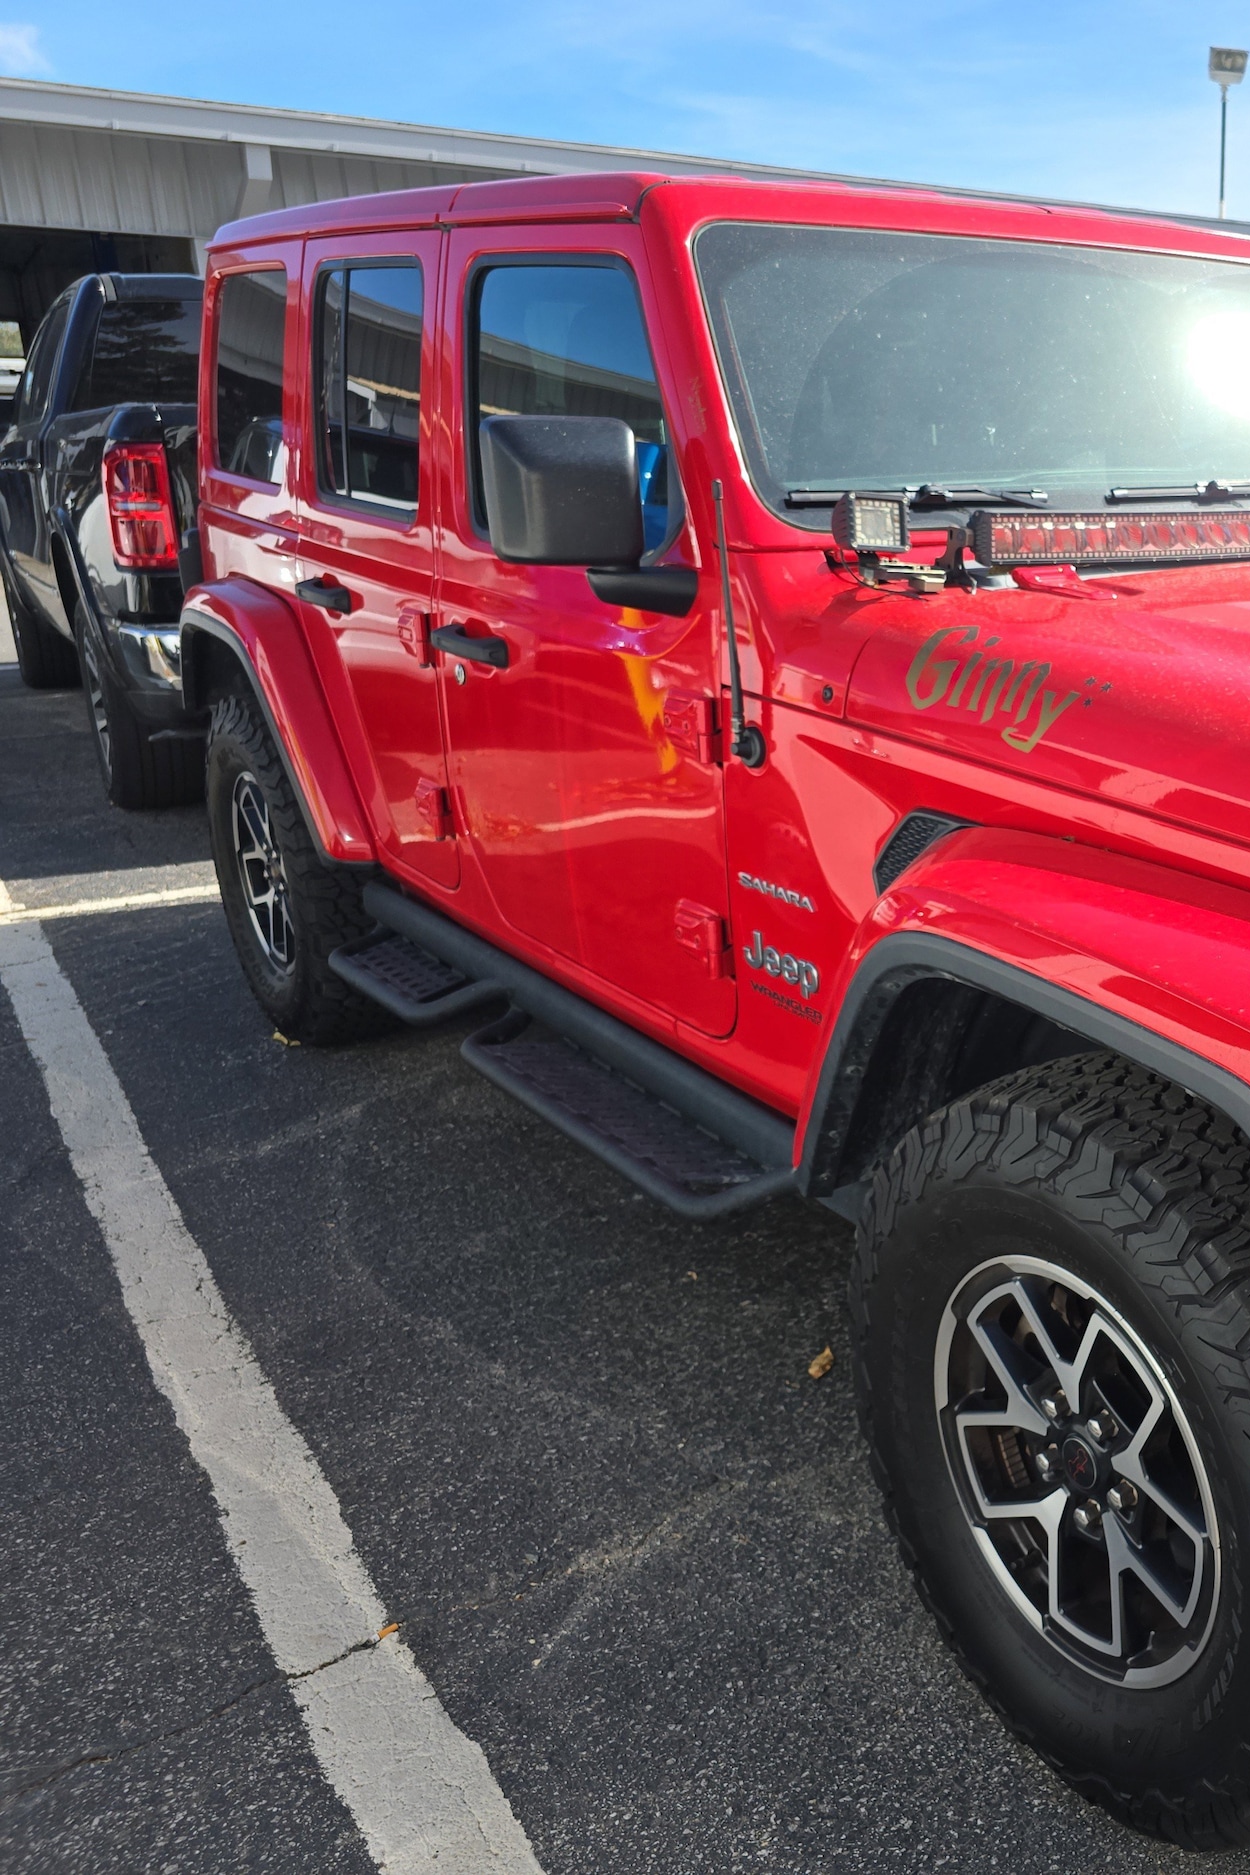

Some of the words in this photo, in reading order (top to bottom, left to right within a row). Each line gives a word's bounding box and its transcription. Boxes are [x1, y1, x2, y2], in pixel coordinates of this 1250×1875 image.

[905, 625, 1081, 754] Ginny
[738, 871, 816, 913] SAHARA
[743, 930, 819, 999] Jeep
